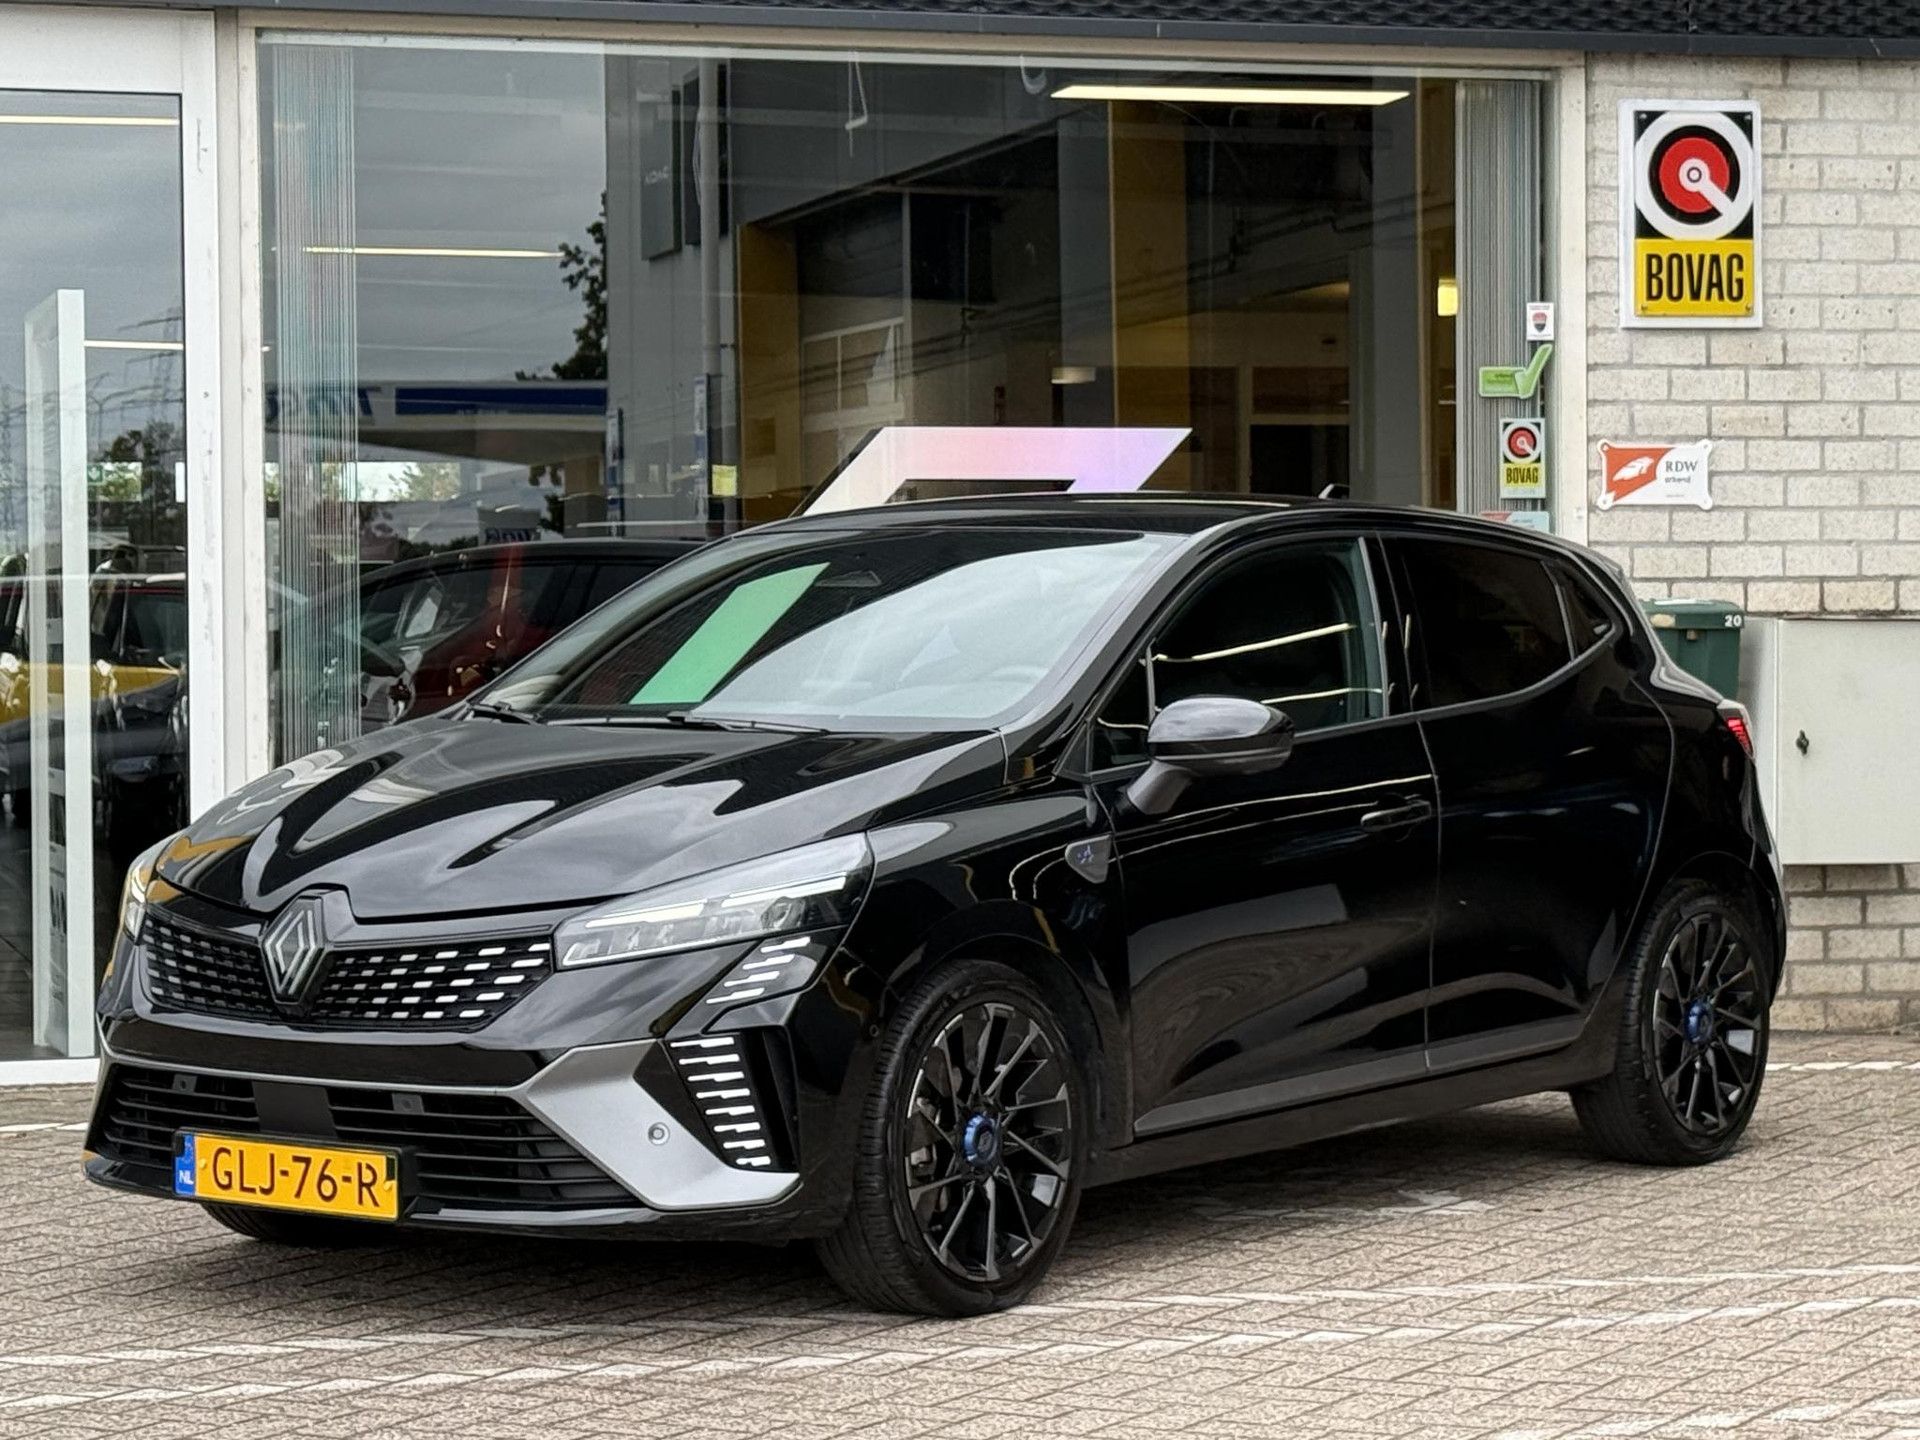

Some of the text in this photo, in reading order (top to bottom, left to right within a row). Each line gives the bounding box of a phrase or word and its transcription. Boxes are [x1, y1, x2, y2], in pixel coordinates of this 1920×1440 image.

[1645, 252, 1744, 303] BOVAG
[1665, 460, 1698, 473] RDW
[1505, 467, 1539, 484] BOVAG
[1724, 614, 1743, 627] 20
[178, 1170, 194, 1185] NL
[212, 1146, 380, 1208] GLJ-76-R
